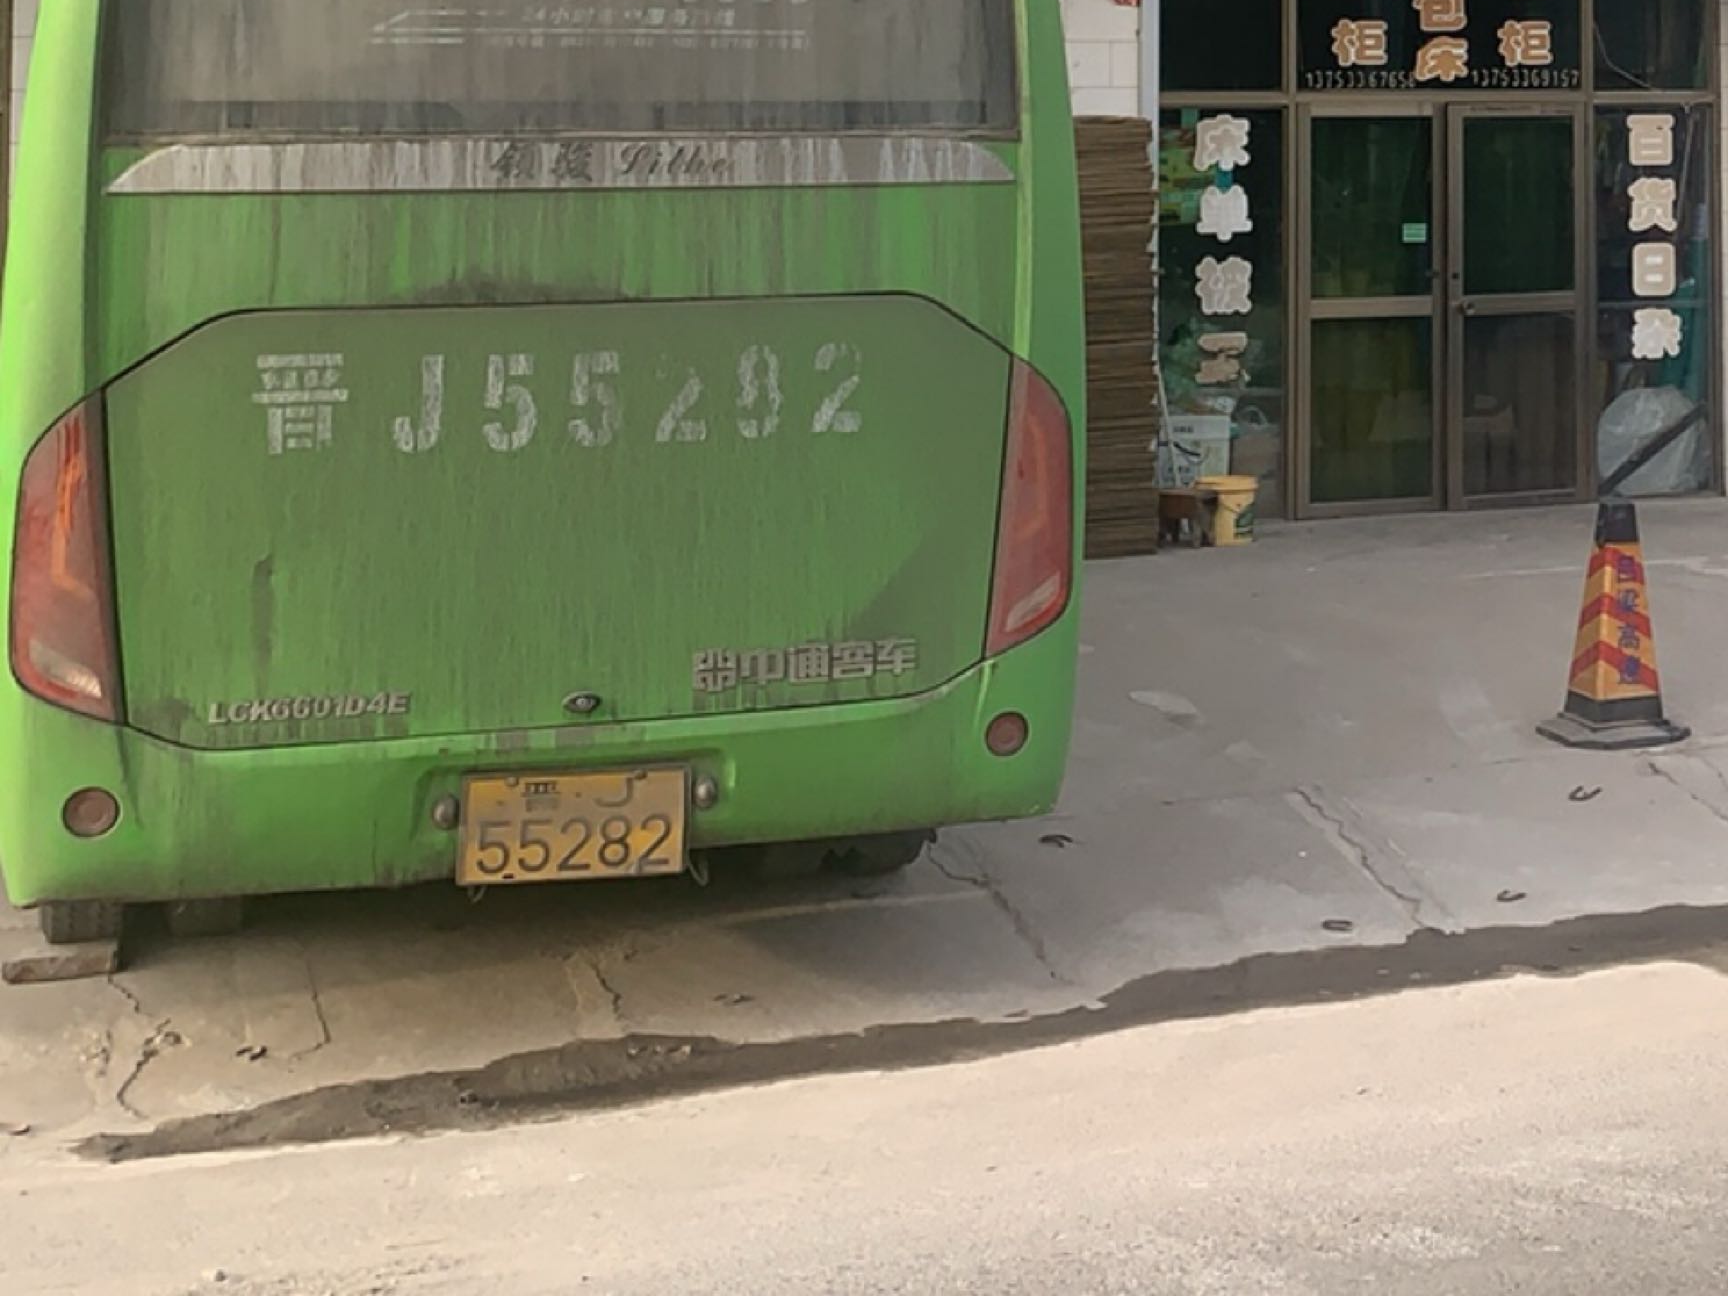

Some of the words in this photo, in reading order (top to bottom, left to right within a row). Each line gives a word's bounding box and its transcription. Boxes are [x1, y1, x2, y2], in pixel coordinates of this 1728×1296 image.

[740, 637, 918, 688] 中通客车
[475, 813, 673, 875] 55282
